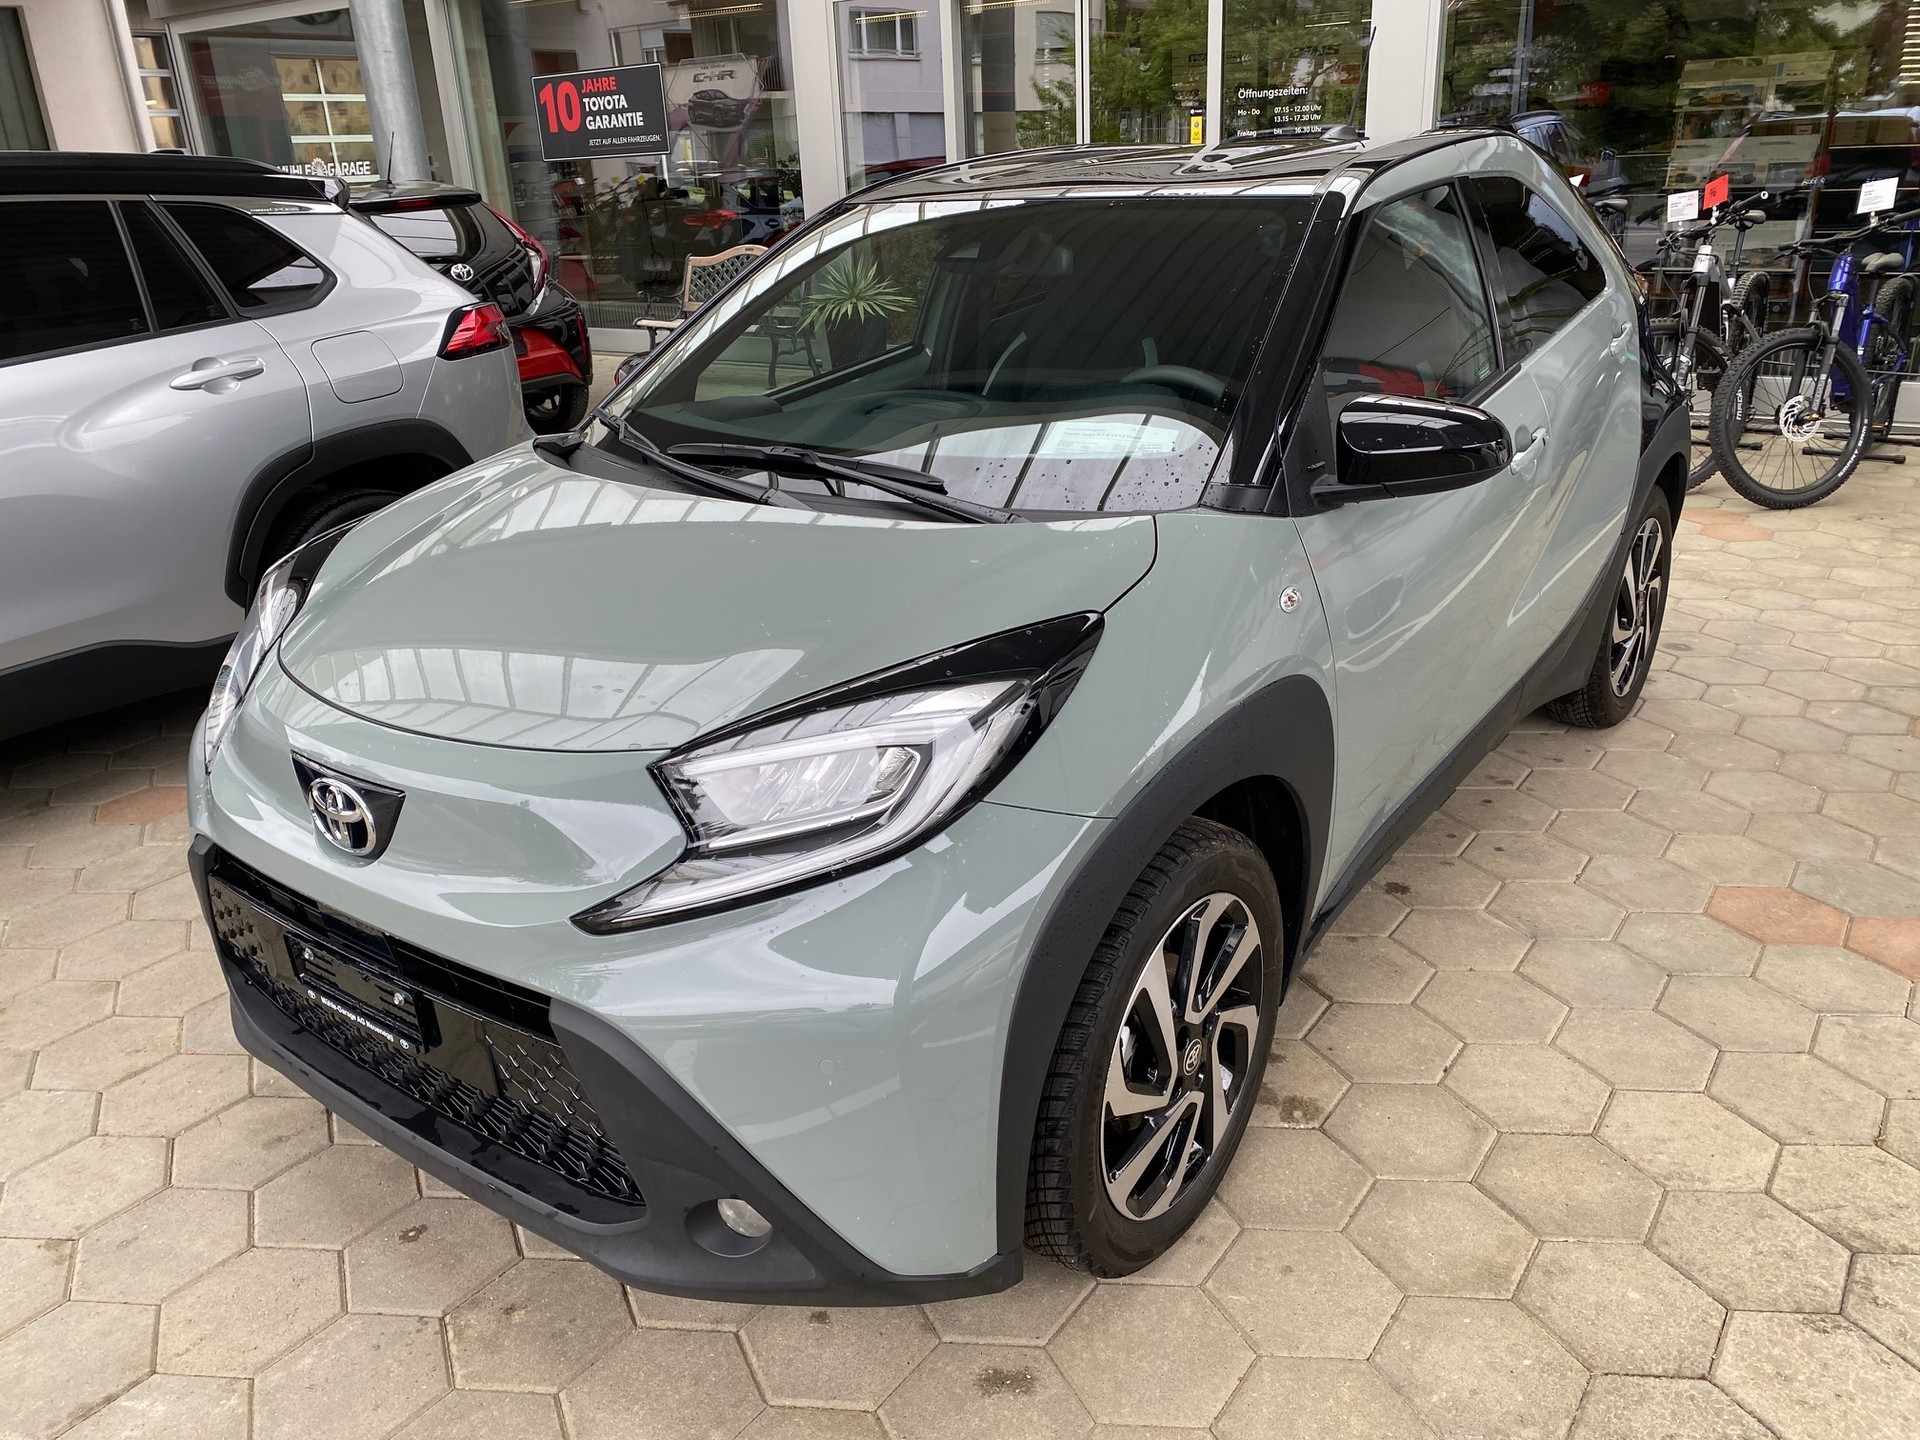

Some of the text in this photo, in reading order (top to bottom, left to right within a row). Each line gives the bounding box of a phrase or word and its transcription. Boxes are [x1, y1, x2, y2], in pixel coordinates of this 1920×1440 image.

[581, 76, 617, 93] JAHRE
[1238, 87, 1309, 99] Öffnungszeiten:
[539, 81, 581, 133] 10
[582, 94, 628, 112] TOYOTA
[1274, 106, 1289, 114] 07.15
[585, 112, 644, 130] GARANTIE
[612, 136, 628, 144] ALLEN
[327, 161, 371, 176] GARAGE
